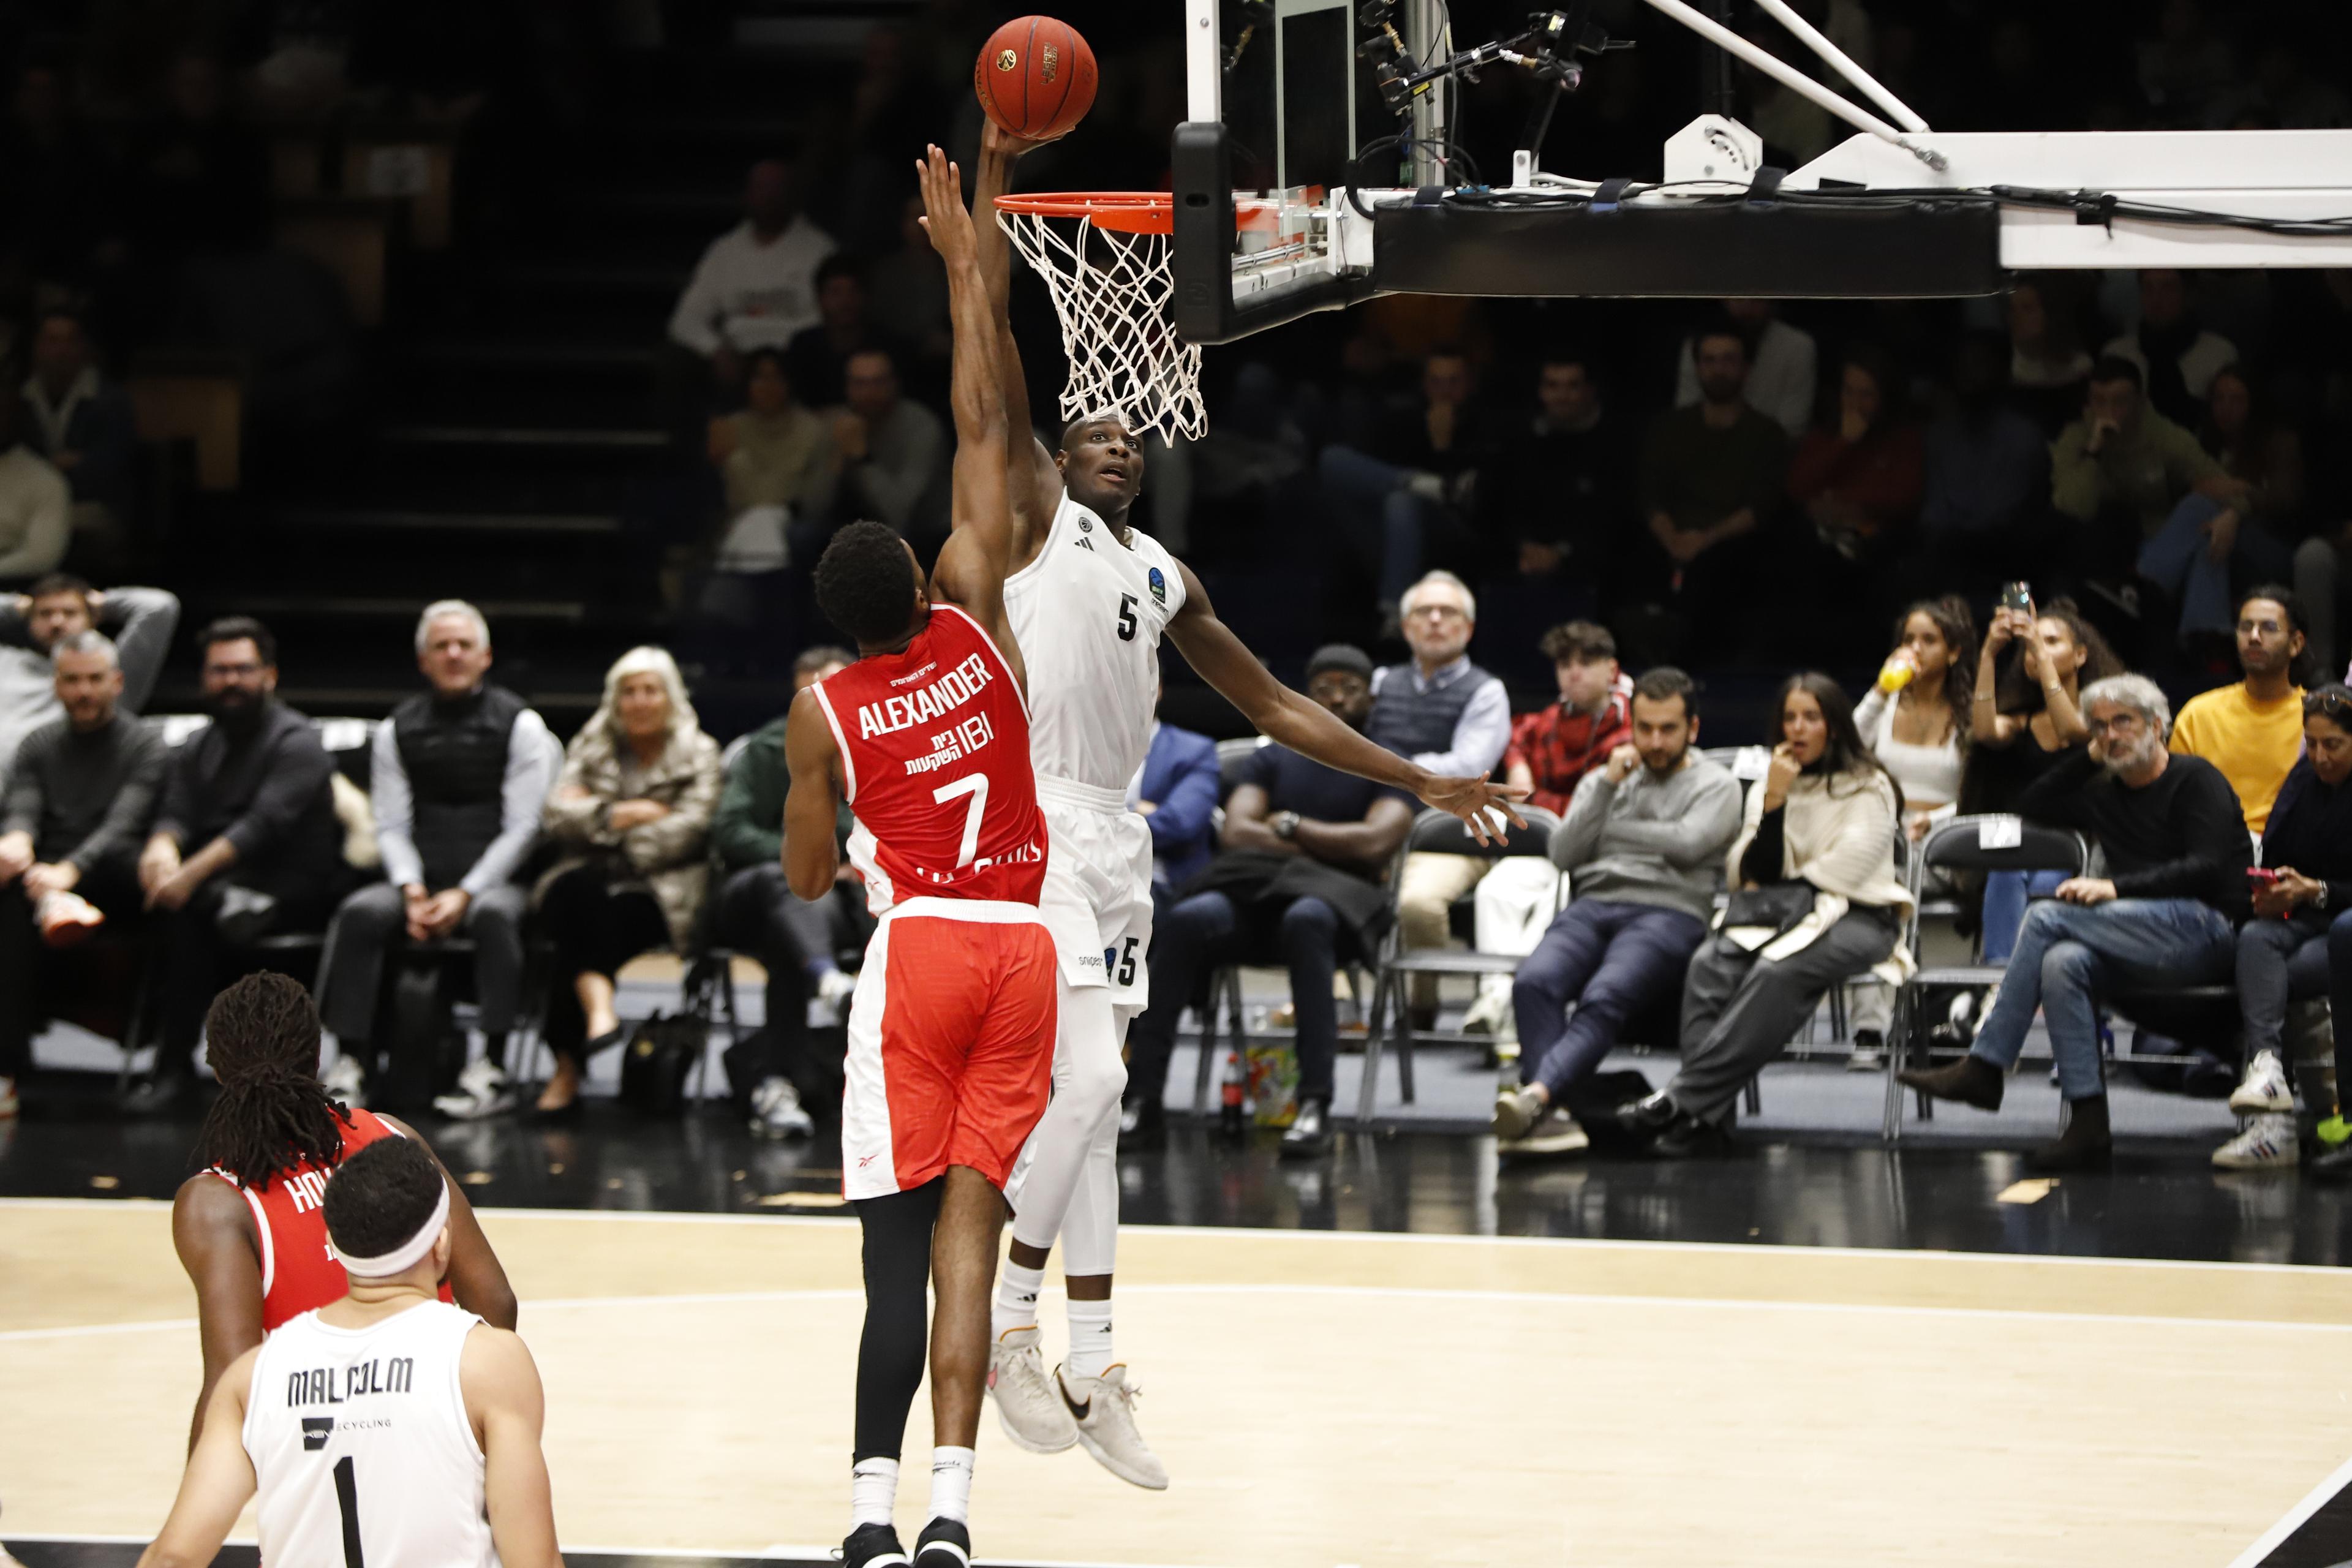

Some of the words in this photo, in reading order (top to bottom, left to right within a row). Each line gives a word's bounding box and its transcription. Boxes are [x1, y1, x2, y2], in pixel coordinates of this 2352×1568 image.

[1118, 592, 1139, 642] 5
[858, 652, 993, 740] ALEXANDER
[930, 729, 957, 751] בית
[955, 710, 995, 755] IBI
[904, 744, 963, 775] השקעות
[932, 772, 990, 870] 7
[1118, 937, 1139, 987] 5
[287, 1357, 414, 1408] MALCOLM
[333, 1456, 365, 1568] 1
